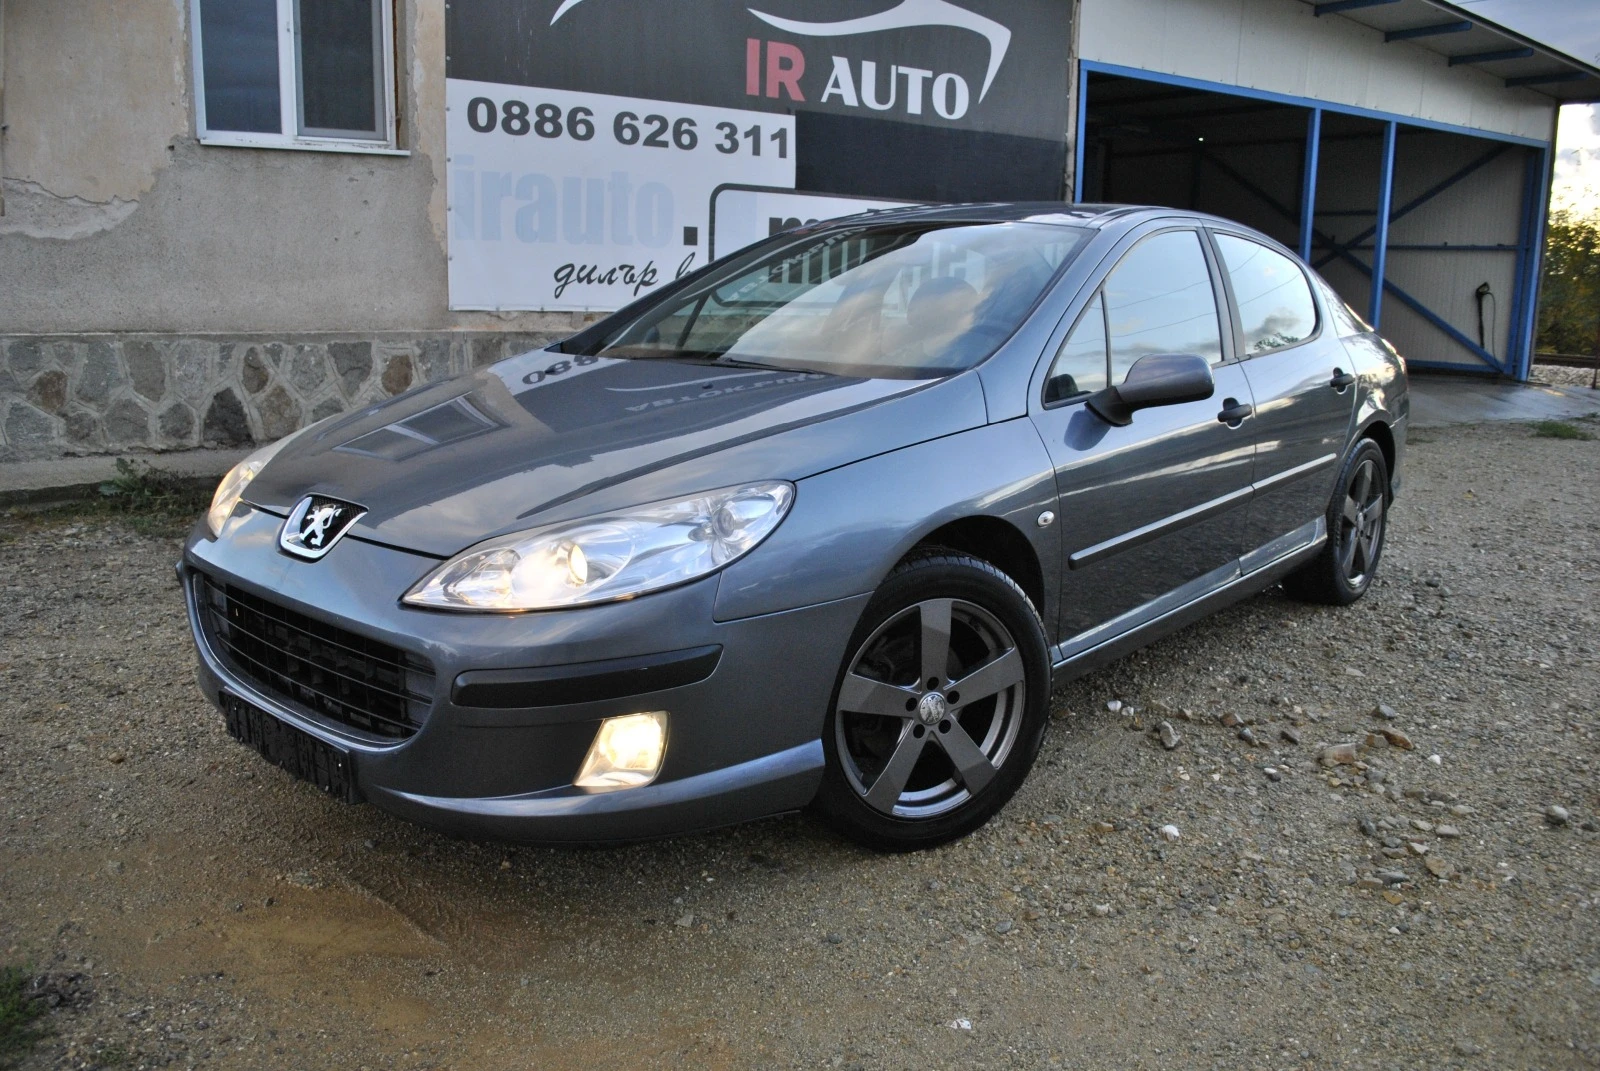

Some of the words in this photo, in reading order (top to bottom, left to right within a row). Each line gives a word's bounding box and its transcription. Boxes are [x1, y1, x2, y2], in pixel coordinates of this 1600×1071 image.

[746, 38, 805, 102] IR
[820, 55, 969, 120] AUTO
[466, 96, 596, 141] 0886
[613, 111, 699, 151] 626
[714, 121, 788, 159] 311
[553, 259, 659, 299] дилър
